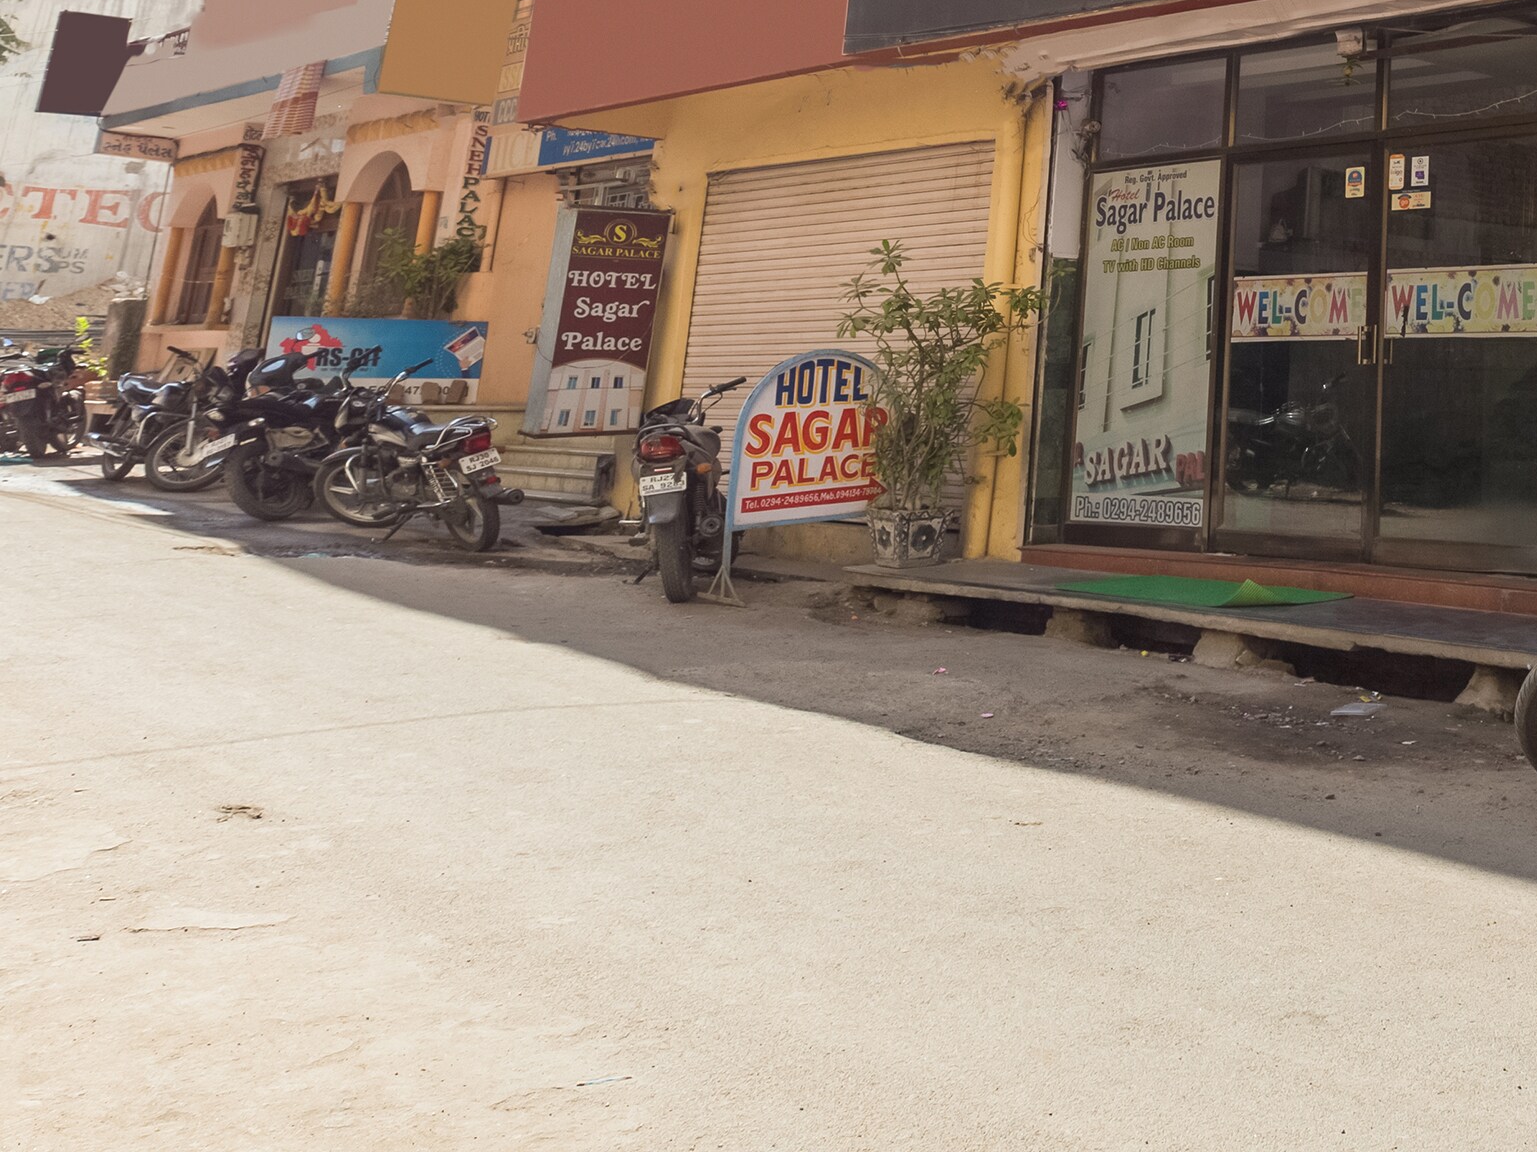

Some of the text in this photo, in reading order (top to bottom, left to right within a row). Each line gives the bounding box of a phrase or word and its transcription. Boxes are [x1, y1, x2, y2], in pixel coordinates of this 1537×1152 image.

[1124, 170, 1188, 185] Reg. Govt. Approved
[455, 176, 481, 239] PALAC
[1109, 189, 1140, 201] Hotel
[1096, 190, 1215, 234] Sagar Palace
[613, 224, 628, 243] S
[1111, 239, 1125, 252] AC
[1131, 238, 1150, 250] Non
[1151, 236, 1165, 249] AC
[1167, 234, 1194, 247] Room
[572, 246, 662, 259] SAGAR PALACE
[1103, 255, 1201, 273] TV with HD Channels
[568, 270, 657, 290] HOTEL
[574, 297, 650, 323] Sagar
[1236, 286, 1364, 326] WEL-COME
[1391, 279, 1537, 323] WEL-COME
[561, 332, 643, 351] Palace
[775, 358, 869, 407] HOTEL
[744, 407, 889, 457] SAGAR
[750, 453, 878, 490] PALACE
[1084, 434, 1174, 486] SAGAR
[1102, 497, 1201, 526] 0294-2489656
